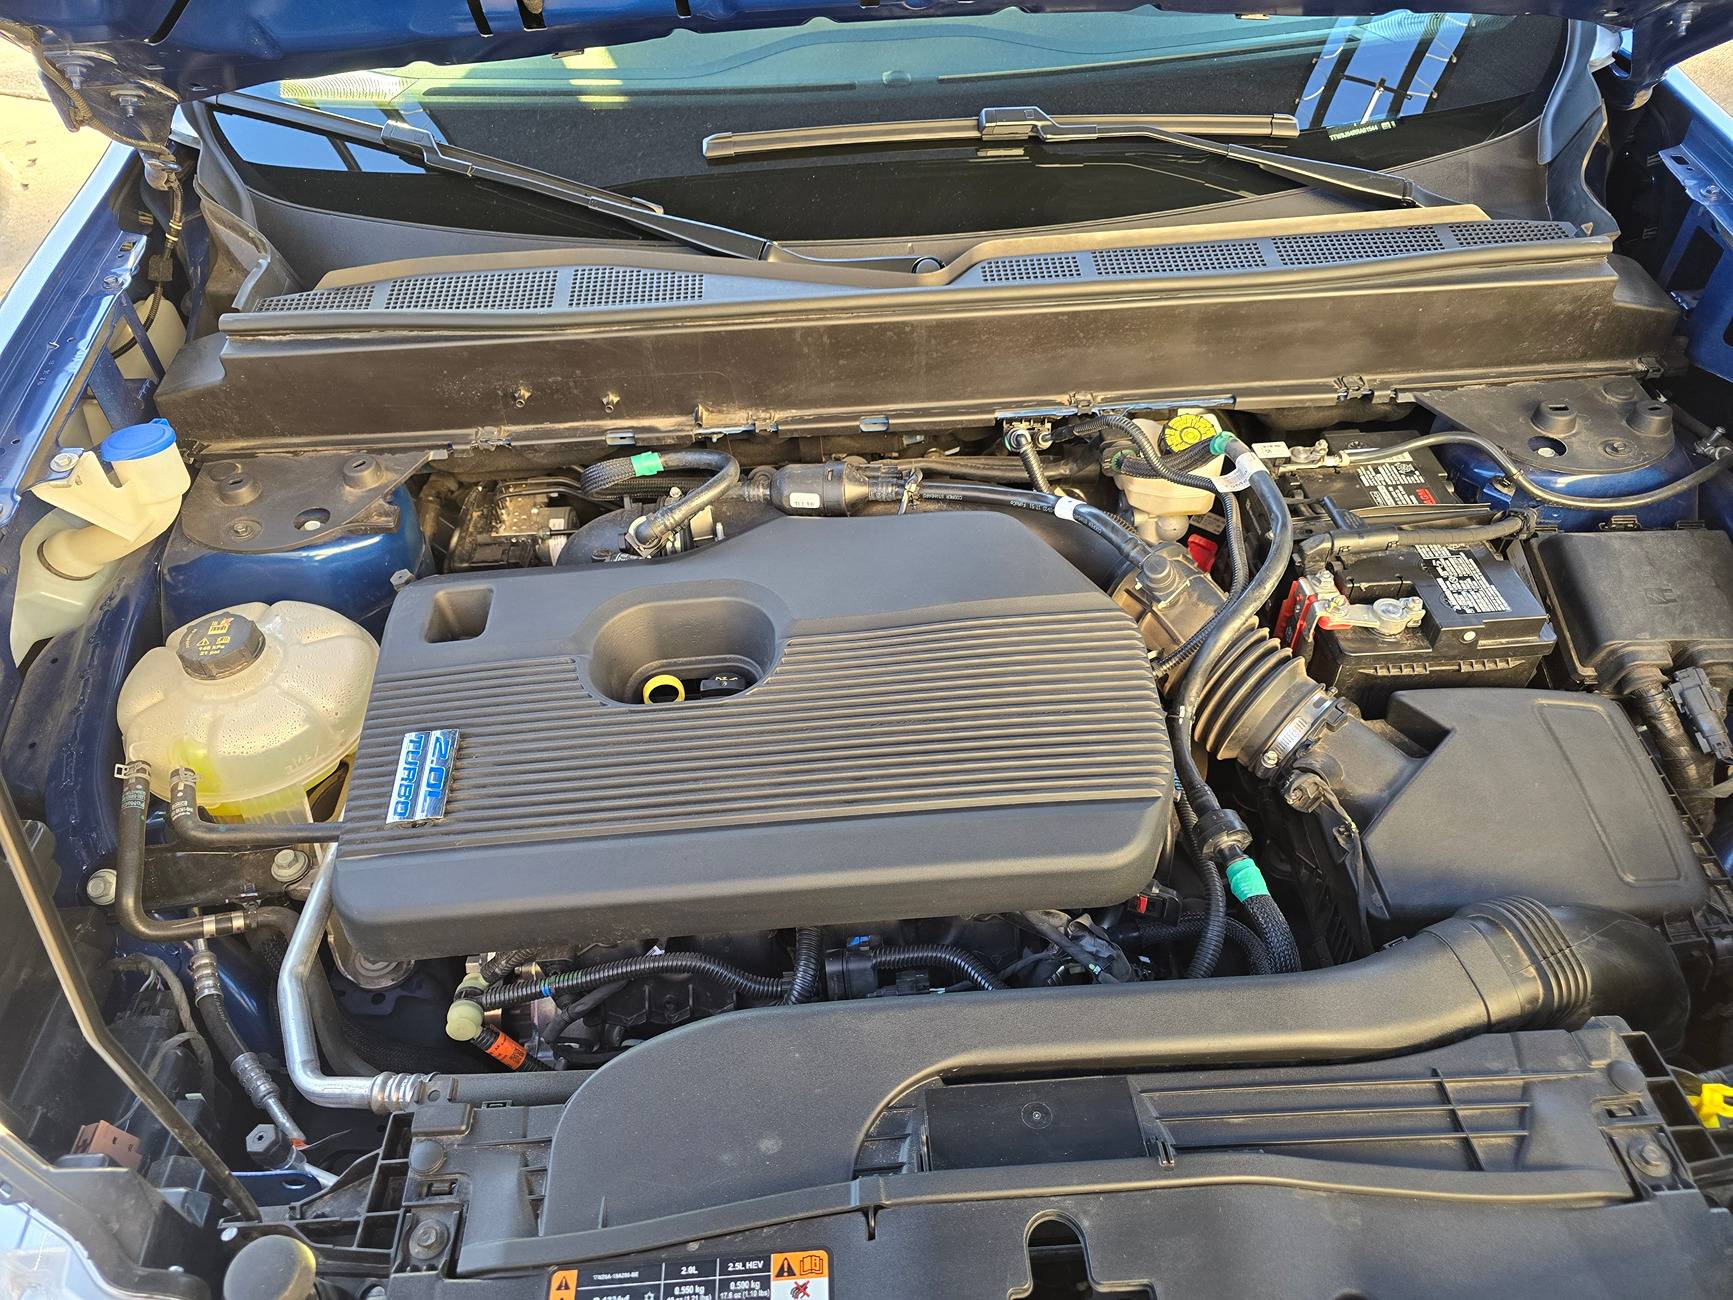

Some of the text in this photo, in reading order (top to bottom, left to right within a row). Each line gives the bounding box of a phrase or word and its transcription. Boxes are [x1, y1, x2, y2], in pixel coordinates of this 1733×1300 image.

[393, 734, 424, 817] TURBO
[420, 735, 451, 814] 2.0L
[680, 1266, 698, 1274] 2.0L
[728, 1260, 764, 1271] 2.5L HEV
[674, 1284, 705, 1295] 0.550 kg
[750, 1280, 760, 1290] kg
